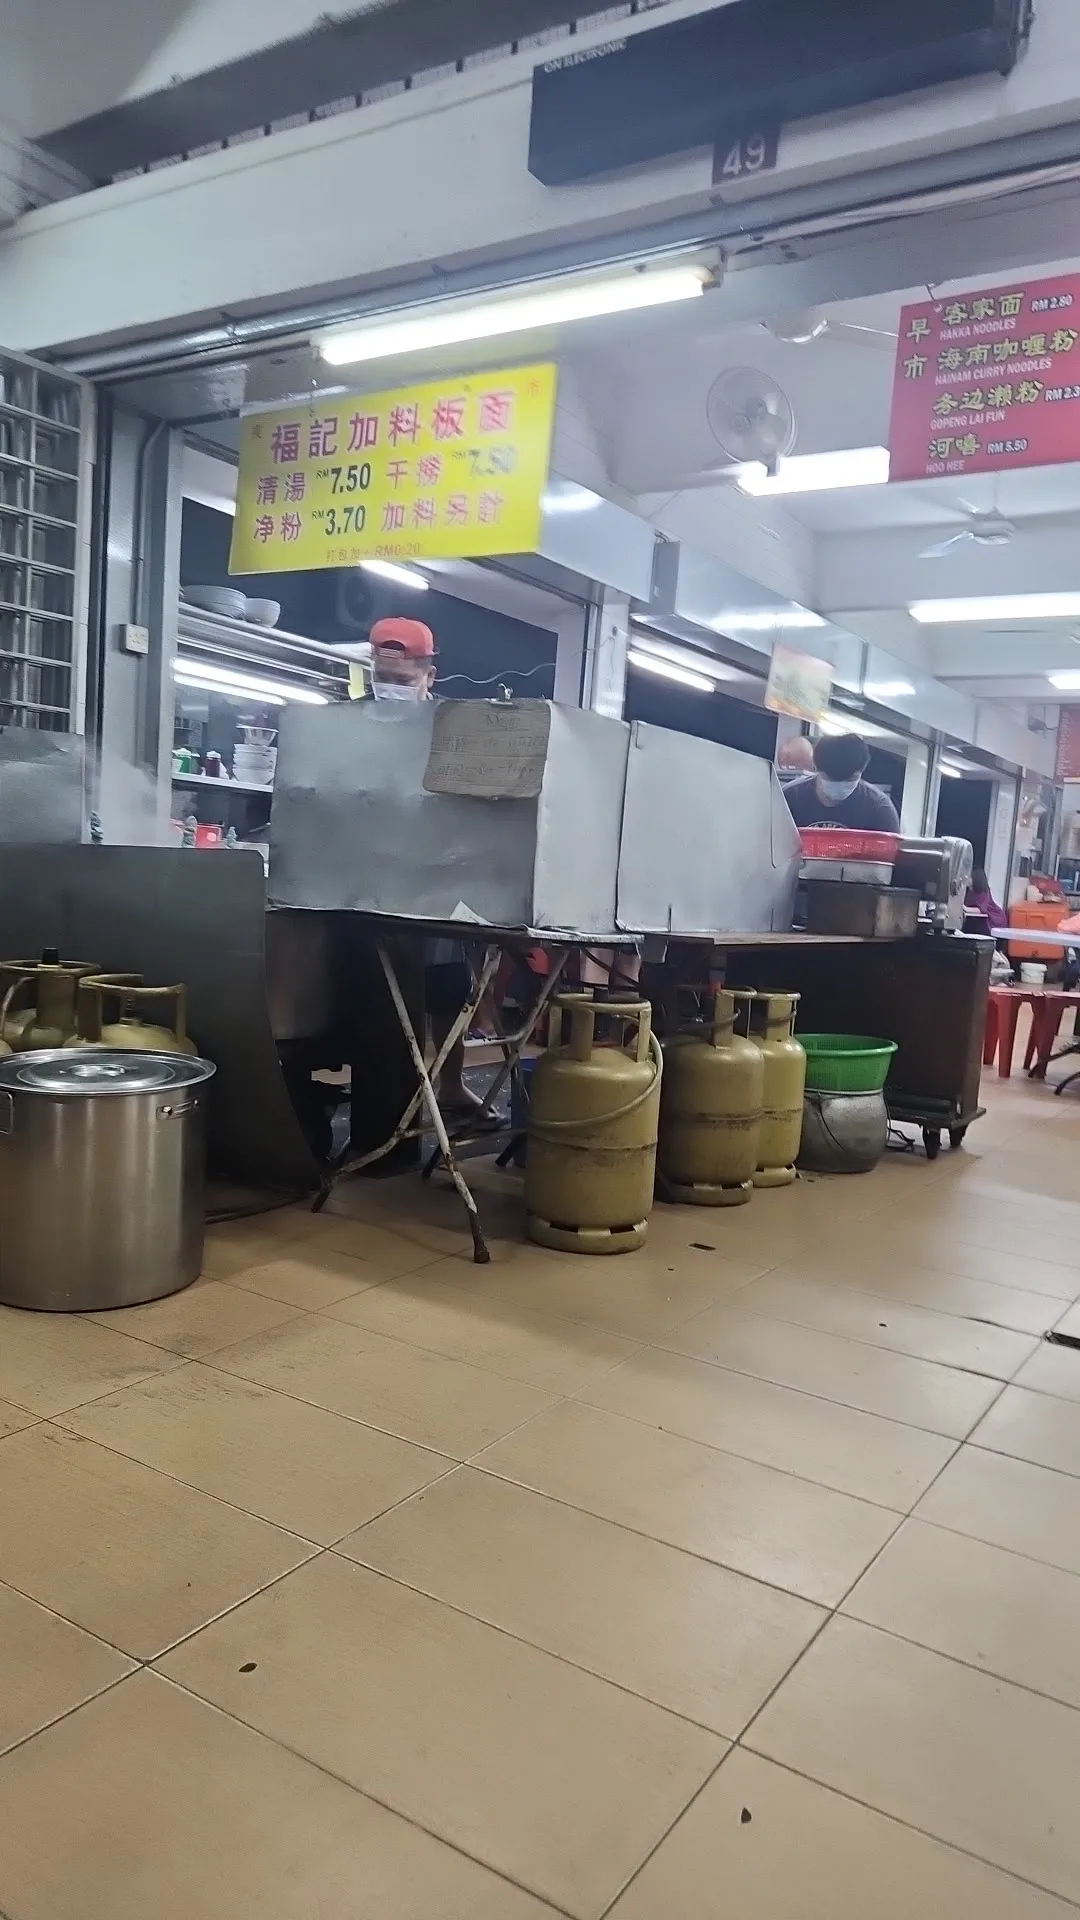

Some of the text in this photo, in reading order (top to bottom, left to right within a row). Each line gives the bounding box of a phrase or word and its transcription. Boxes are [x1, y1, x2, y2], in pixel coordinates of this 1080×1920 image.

[722, 133, 766, 176] 49
[942, 291, 1024, 326] 客家面
[1031, 294, 1072, 312] RM 2.80
[940, 318, 1017, 341] HAKKA NOODLES
[973, 363, 1006, 382] CURRY
[1006, 357, 1053, 375] NOODLES
[1045, 388, 1063, 402] RM
[270, 389, 516, 464] 福記加料板面
[930, 410, 1006, 430] GOPENG LAI FUN
[986, 438, 1028, 456] RM 5.50
[316, 468, 330, 480] RM
[330, 462, 371, 495] 7.50
[312, 509, 326, 520] RM
[325, 505, 366, 536] 3.70
